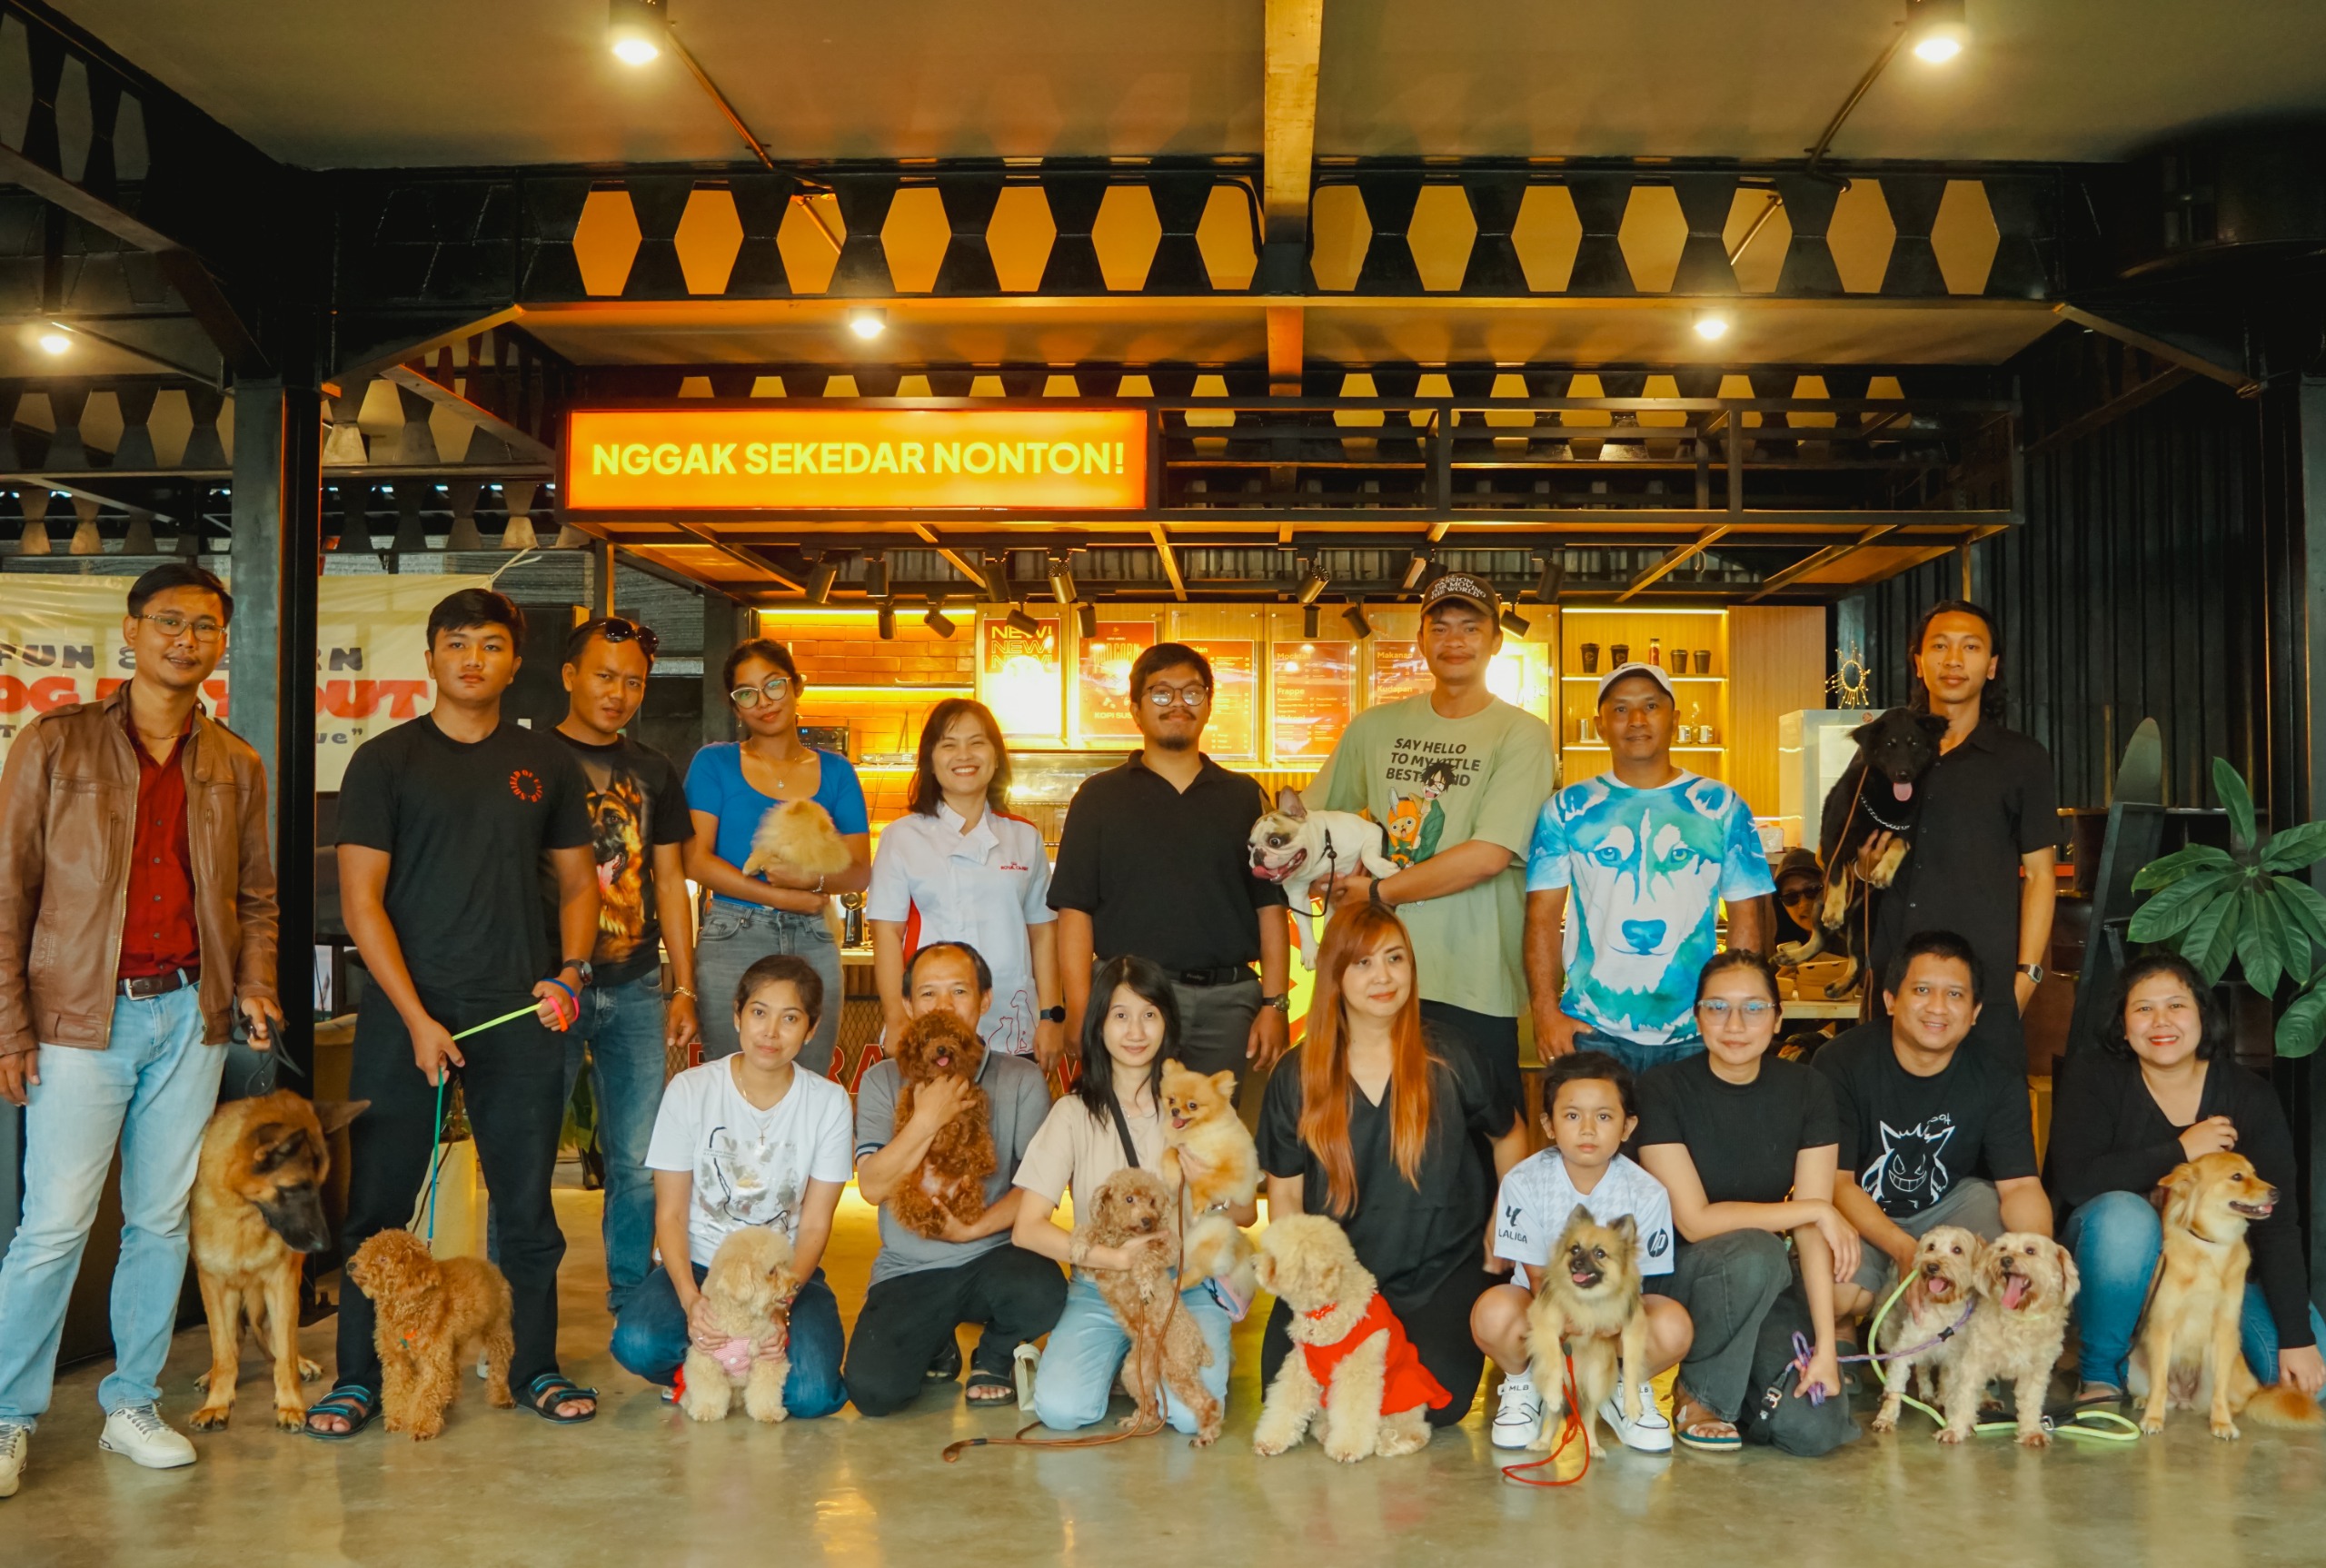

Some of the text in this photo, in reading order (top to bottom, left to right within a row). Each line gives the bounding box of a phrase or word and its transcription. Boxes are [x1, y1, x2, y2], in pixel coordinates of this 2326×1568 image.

[592, 442, 1125, 475] NGGAK SEKEDAR NONTON!
[1430, 586, 1479, 600] THE WORLD
[1449, 581, 1486, 598] MOVING
[1277, 688, 1306, 696] Frappe
[1377, 685, 1413, 694] Kudapan
[1394, 738, 1466, 755] SAY HELLO
[1391, 752, 1408, 765] TO
[1410, 755, 1434, 768] MY
[1386, 767, 1423, 783] BEST
